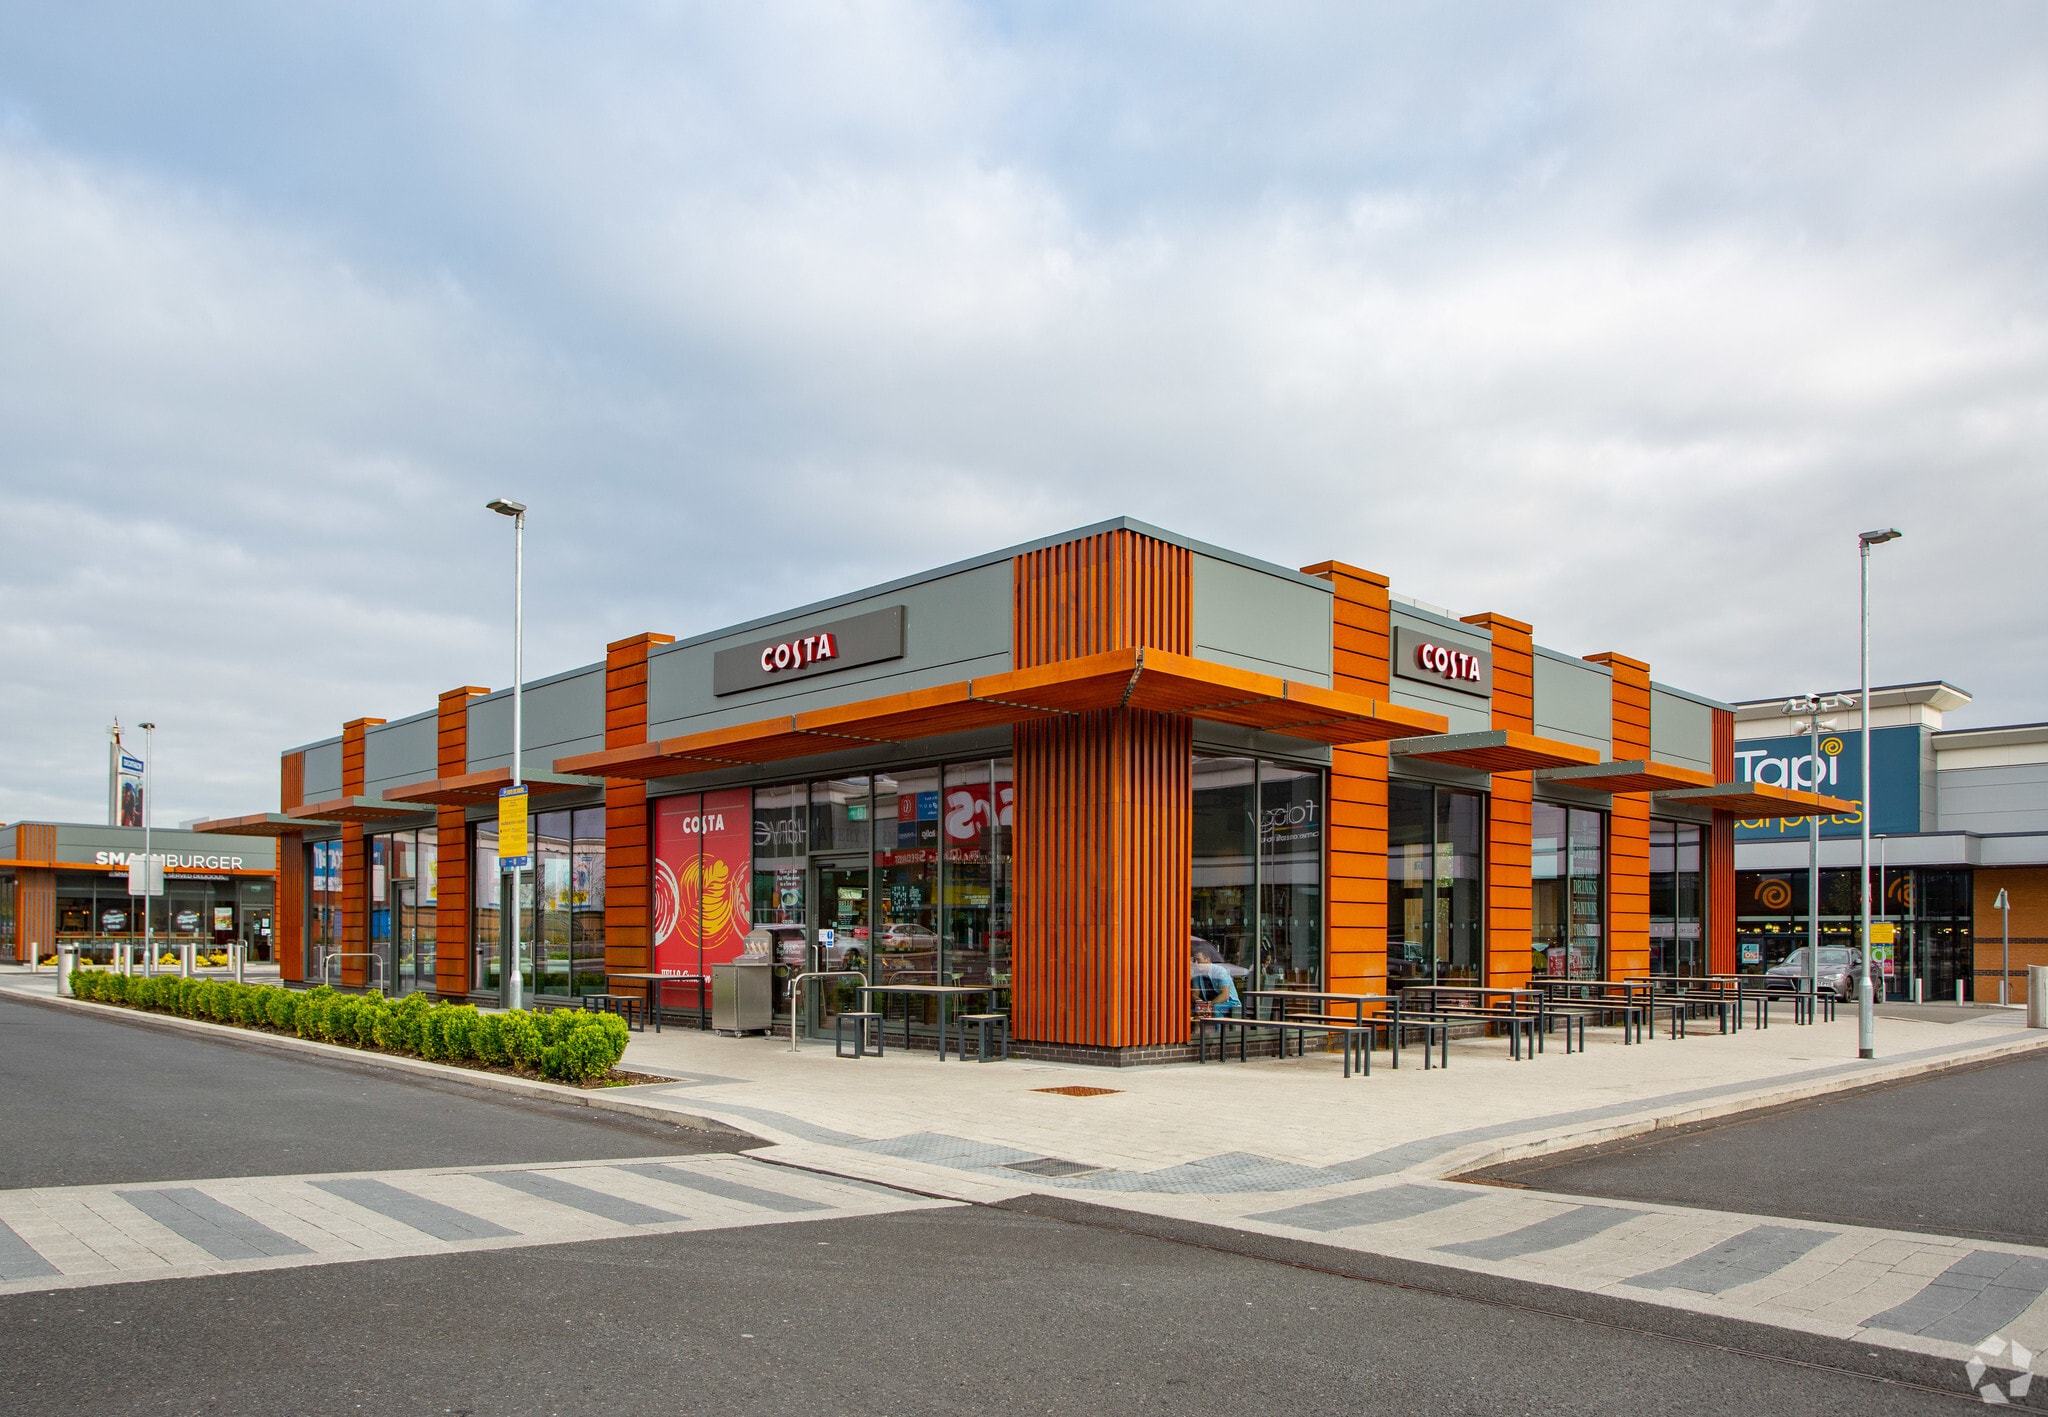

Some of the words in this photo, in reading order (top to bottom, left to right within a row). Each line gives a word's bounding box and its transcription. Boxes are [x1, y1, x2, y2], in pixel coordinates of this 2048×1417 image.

[761, 633, 834, 672] COSTA
[1421, 643, 1481, 681] COSTA
[1734, 738, 1843, 793] Tapi
[682, 814, 725, 834] COSTA
[1573, 880, 1597, 894] DRINKS
